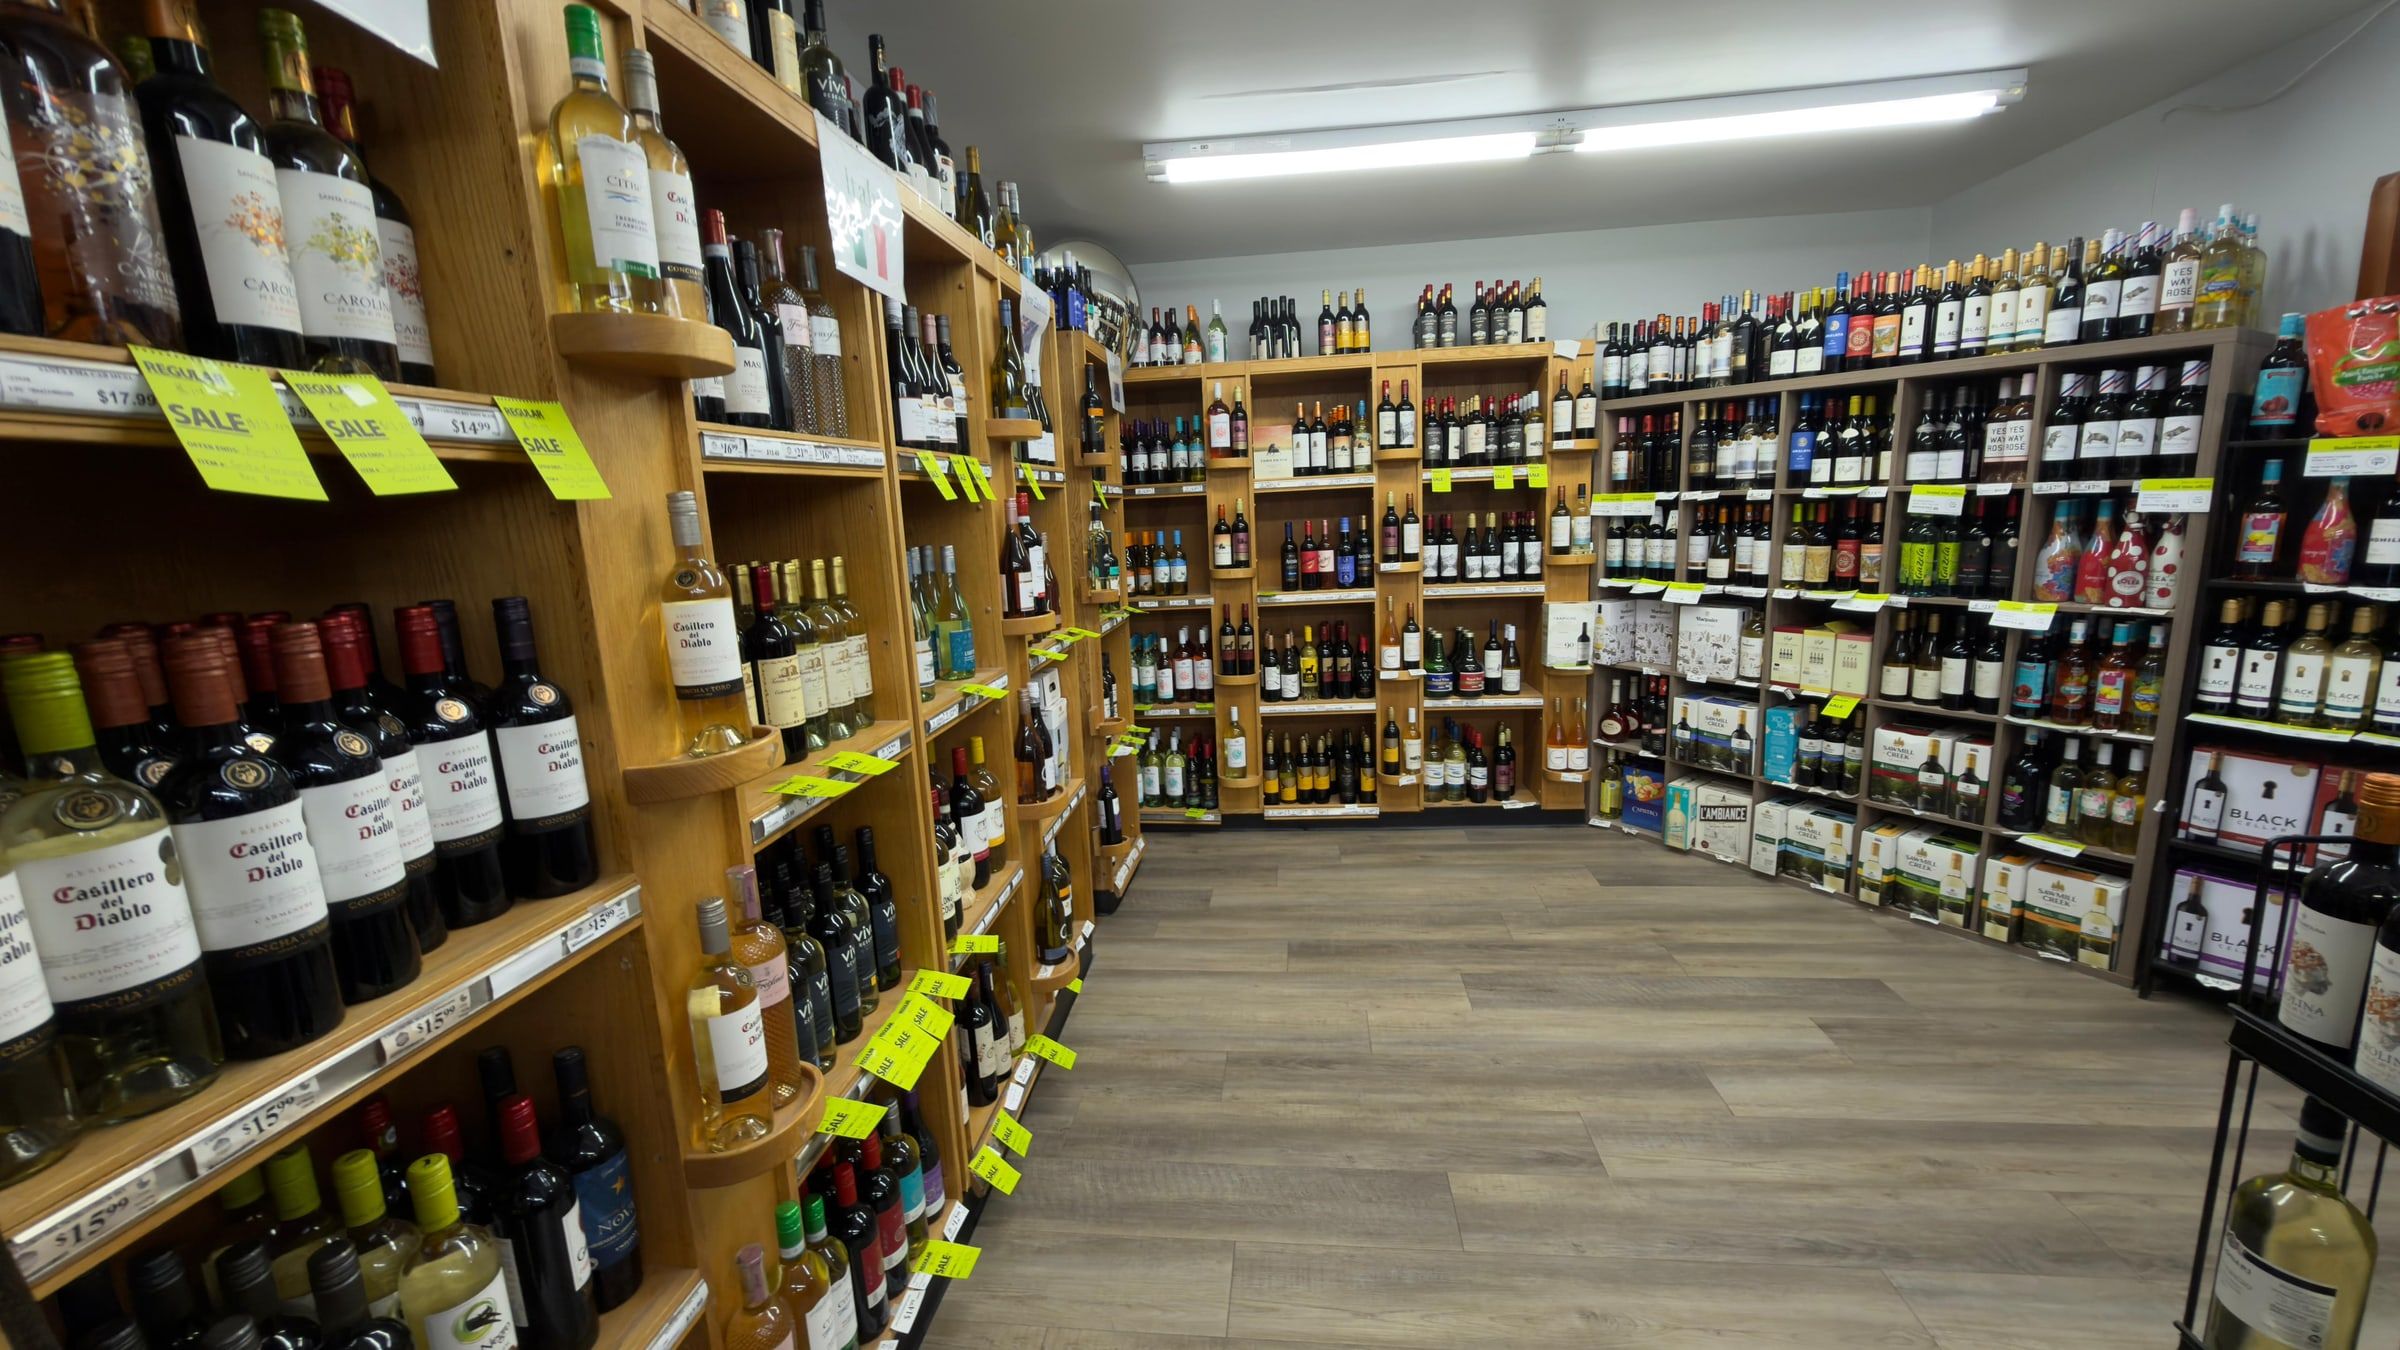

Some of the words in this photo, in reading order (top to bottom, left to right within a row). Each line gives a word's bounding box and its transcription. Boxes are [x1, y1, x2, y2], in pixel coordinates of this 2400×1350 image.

[817, 76, 847, 99] vivo
[2173, 267, 2192, 277] YES
[2171, 278, 2192, 288] WAY
[168, 404, 250, 434] SALE
[504, 406, 544, 420] REGULAR
[325, 419, 386, 438] SALE
[523, 437, 563, 454] SALE
[673, 621, 715, 633] Casillero
[680, 639, 712, 649] Diablo
[2283, 687, 2314, 696] BLACK
[2328, 691, 2361, 701] BLACK
[559, 751, 570, 760] del
[1882, 744, 1914, 756] SAWMILL
[1886, 751, 1910, 760] CREEK
[438, 755, 488, 775] Casillero
[548, 757, 579, 773] Diablo
[464, 769, 476, 779] del
[449, 775, 488, 793] Diablo
[373, 812, 385, 824] del
[1700, 807, 1747, 821] L'AMBIANCE
[2230, 808, 2298, 829] BLACK
[359, 819, 394, 840] Diablo
[2237, 820, 2286, 833] CELLAR
[229, 831, 304, 860] Casillero
[267, 850, 287, 865] del
[1905, 854, 1936, 867] SAWMILL
[247, 857, 304, 884] Diablo
[1908, 860, 1932, 872] CREEK
[52, 871, 155, 905] Casillero
[2038, 888, 2077, 903] SAWMILL
[100, 895, 124, 909] del
[2042, 895, 2071, 907] CREEK
[73, 902, 152, 932] Diablo
[965, 939, 975, 953] SALE
[2211, 931, 2276, 955] BLAK
[157, 969, 194, 992] TORO
[930, 980, 943, 994] SALE
[913, 1006, 928, 1025] SALE
[894, 1031, 911, 1049] SALE
[876, 1056, 894, 1077] SALE
[825, 1111, 848, 1134] SALE
[1003, 1126, 1013, 1143] SALE
[985, 1164, 998, 1181] SALE
[935, 1254, 951, 1274] SALE
